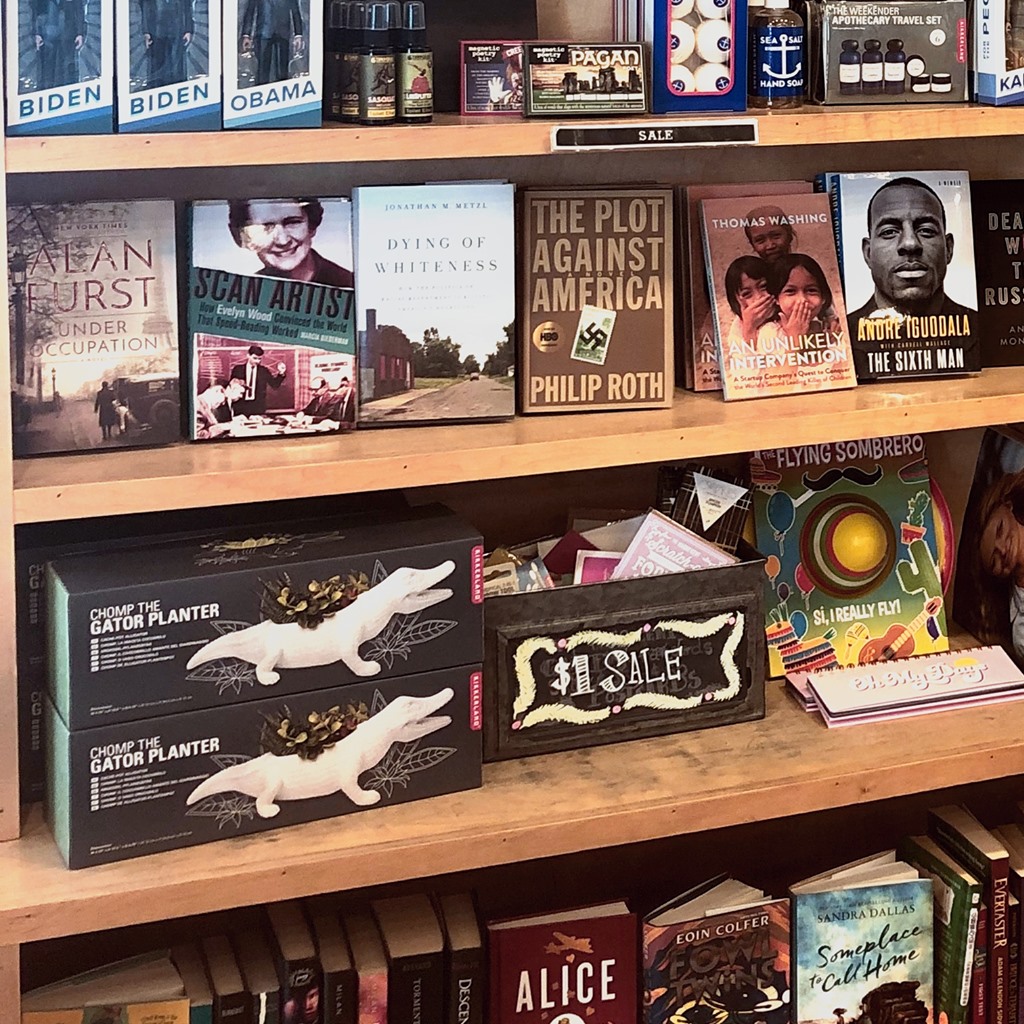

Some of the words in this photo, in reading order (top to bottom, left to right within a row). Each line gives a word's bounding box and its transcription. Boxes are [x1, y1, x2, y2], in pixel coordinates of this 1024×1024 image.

[832, 15, 890, 25] APOTHECARY
[891, 16, 924, 25] TRAVEL
[925, 16, 943, 25] SET
[759, 35, 778, 45] SEA
[571, 48, 640, 68] PAGAN
[130, 81, 209, 116] BIDEN
[230, 79, 317, 113] OBAMA
[760, 79, 784, 89] HAND
[19, 84, 101, 119] BIDEN
[638, 129, 674, 141] SALE
[531, 200, 585, 235] THE
[594, 199, 664, 233] PLOT
[30, 239, 154, 278] ALAN
[387, 236, 451, 252] DYING
[462, 236, 487, 249] OF
[532, 236, 664, 273] AGAINST
[374, 260, 499, 274] WHITENESS
[25, 277, 156, 315] FURST
[194, 269, 263, 307] SCAN
[269, 280, 355, 320] ARTIST
[532, 275, 664, 313] AMERICA
[29, 334, 159, 356] OCCUPATION
[728, 336, 759, 356] AN
[763, 330, 845, 352] UNLIKELY
[728, 349, 847, 372] INTERVENTION
[867, 351, 891, 373] THE
[895, 349, 933, 372] SIXTH
[937, 348, 964, 369] MAN
[530, 374, 602, 403] PHILIP
[607, 371, 664, 401] ROTH
[776, 443, 833, 470] FLYING
[835, 434, 925, 462] SOMBRERO
[89, 604, 135, 622] CHOMP
[138, 598, 161, 614] THE
[89, 613, 145, 636] GATOR
[147, 602, 220, 628] PLANTER
[551, 653, 594, 697] $1
[599, 645, 683, 694] SALE
[816, 908, 867, 924] SANDRA
[869, 903, 916, 917] DALLAS
[515, 958, 617, 1014] ALICE
